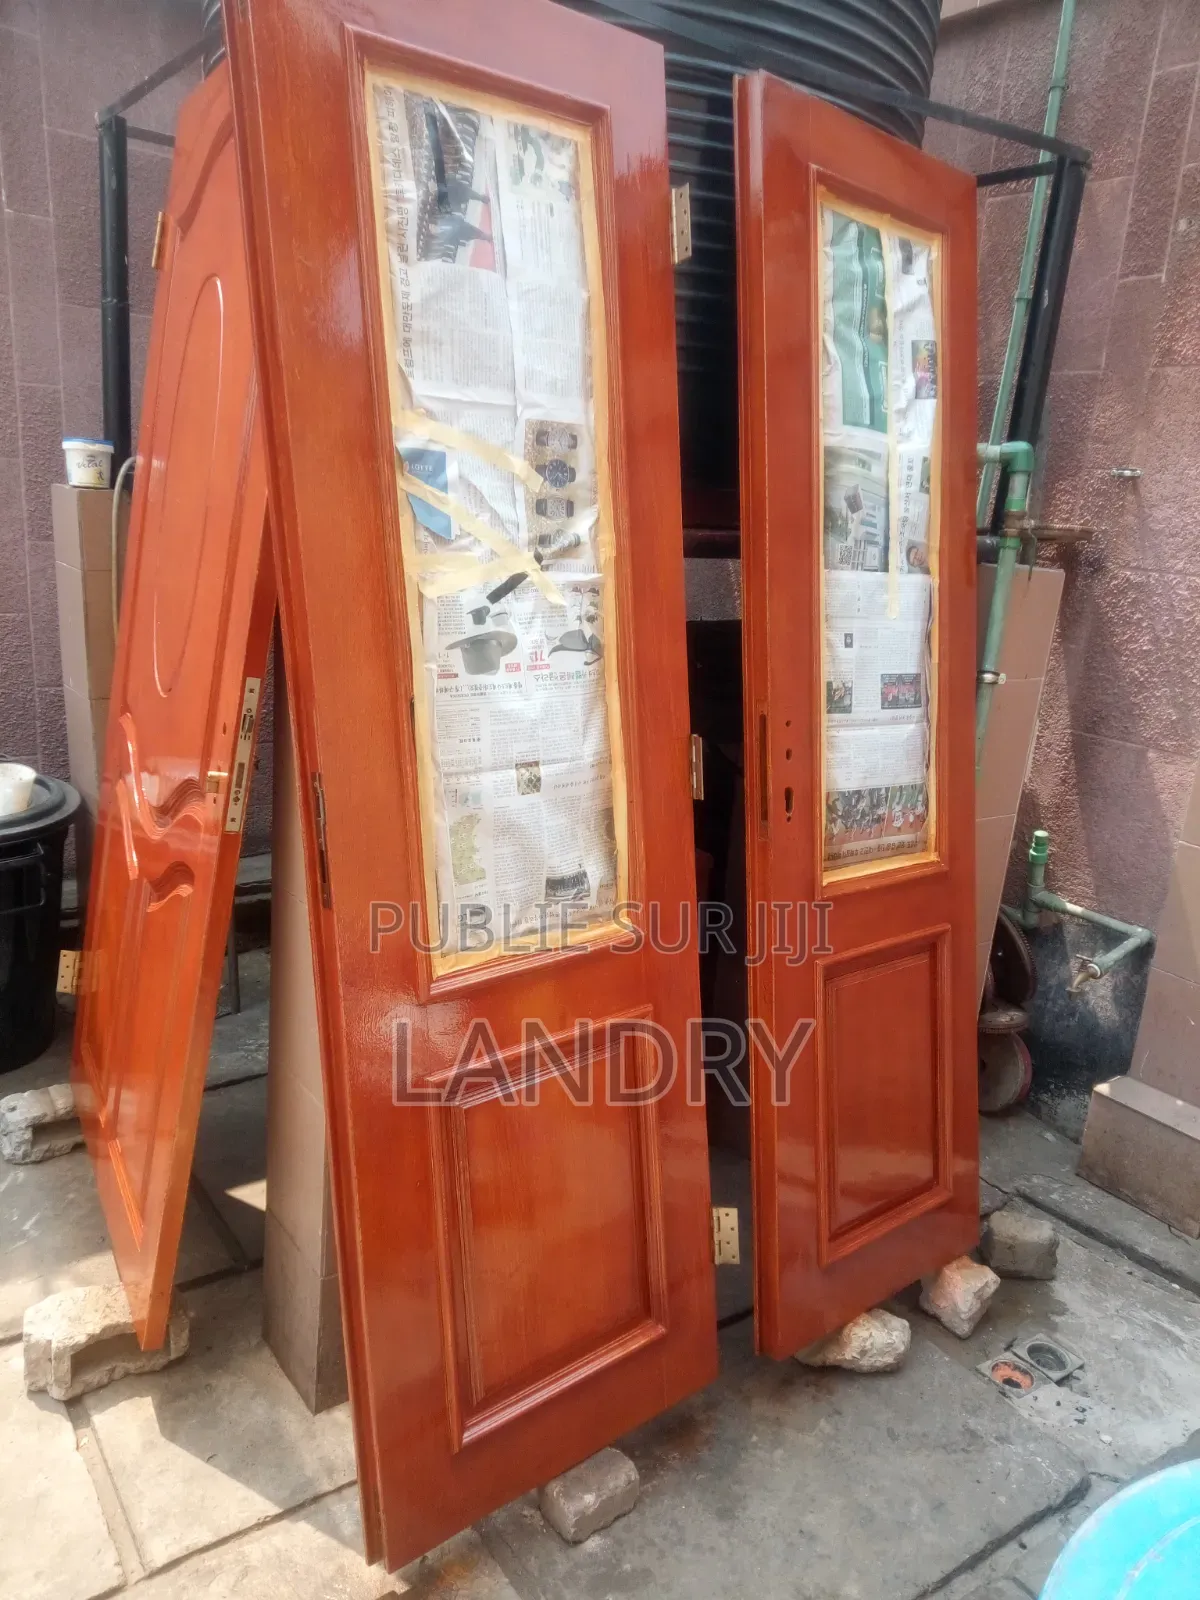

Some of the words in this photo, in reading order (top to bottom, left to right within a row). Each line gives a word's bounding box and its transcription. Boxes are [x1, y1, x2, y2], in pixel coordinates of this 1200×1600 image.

[396, 206, 409, 238] 시진핑
[396, 243, 408, 264] 날린
[398, 268, 410, 287] 경고
[400, 291, 413, 333] 대만문제
